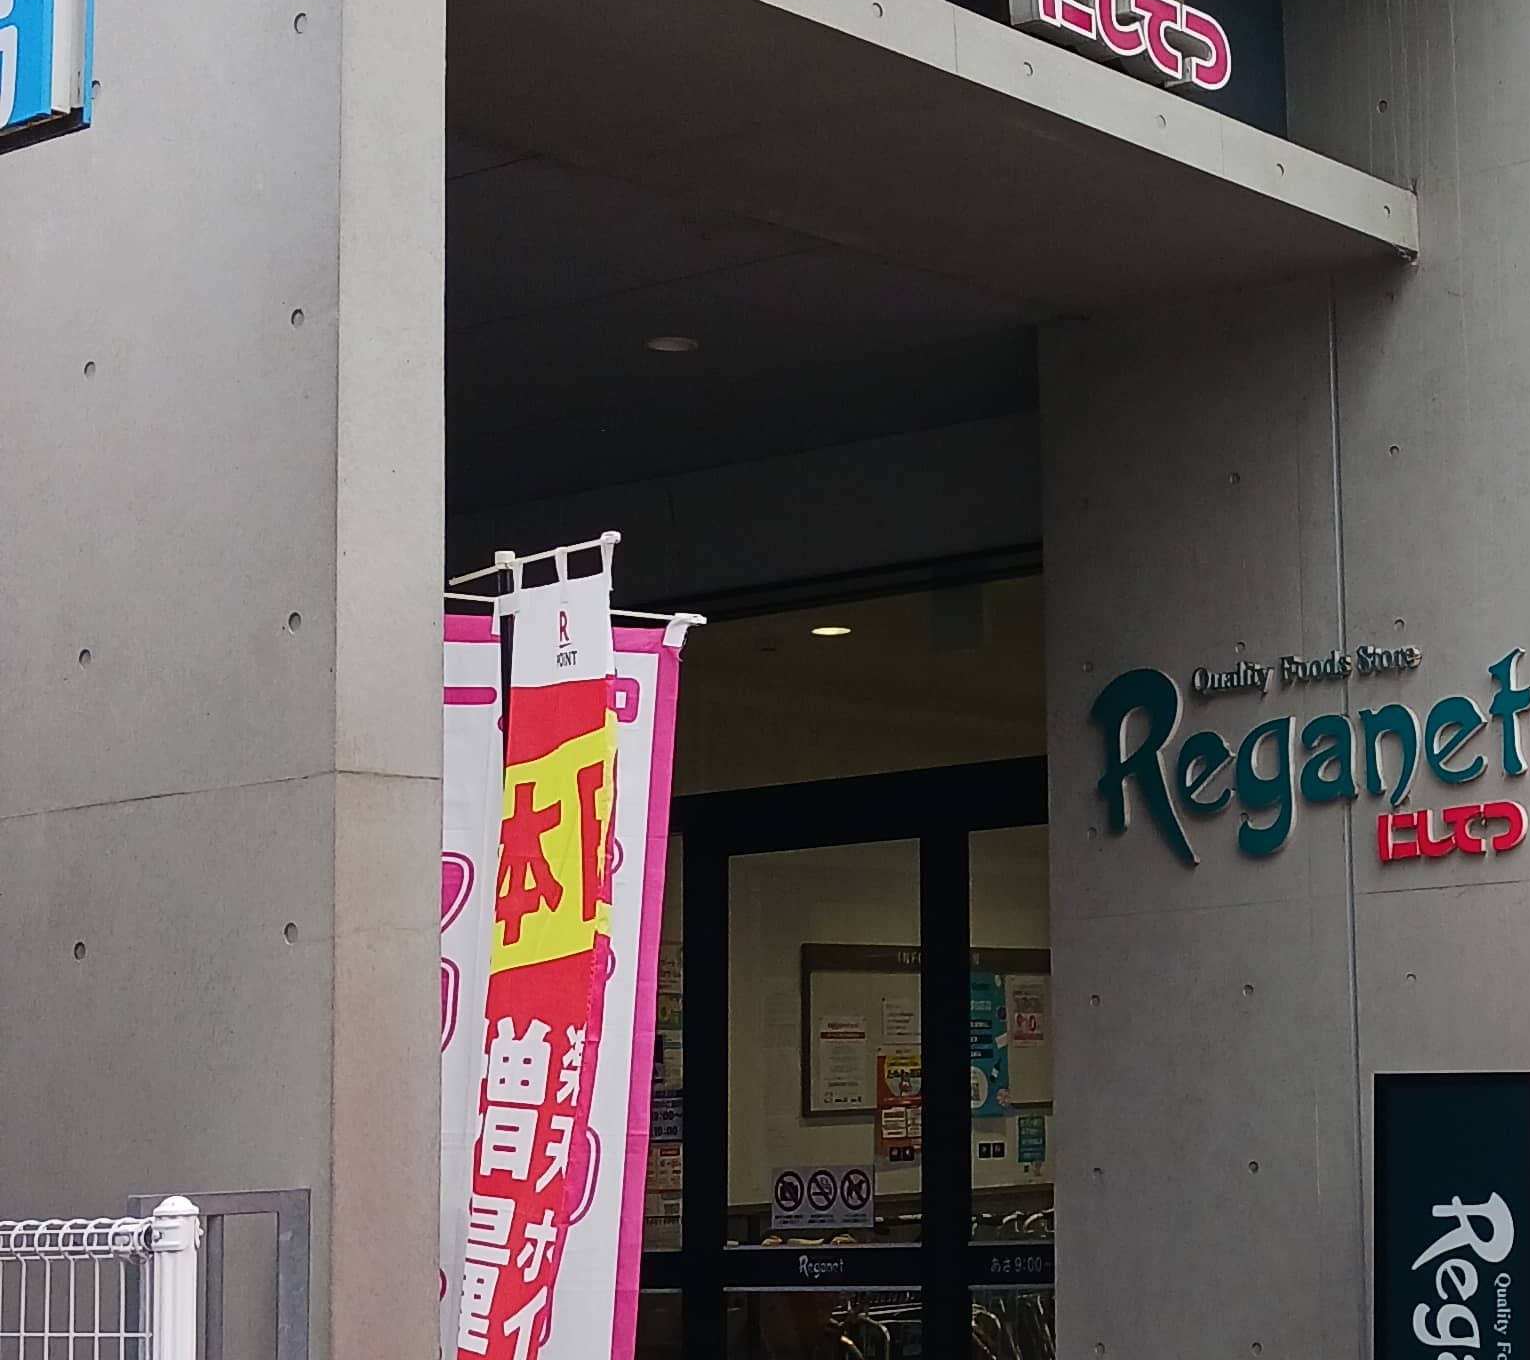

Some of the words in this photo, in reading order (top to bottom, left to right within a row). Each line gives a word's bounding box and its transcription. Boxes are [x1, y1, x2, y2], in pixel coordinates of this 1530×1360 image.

[1192, 659, 1275, 694] Quality
[1281, 649, 1352, 682] Foods
[1356, 644, 1423, 674] Store
[1494, 1272, 1511, 1335] Quality
